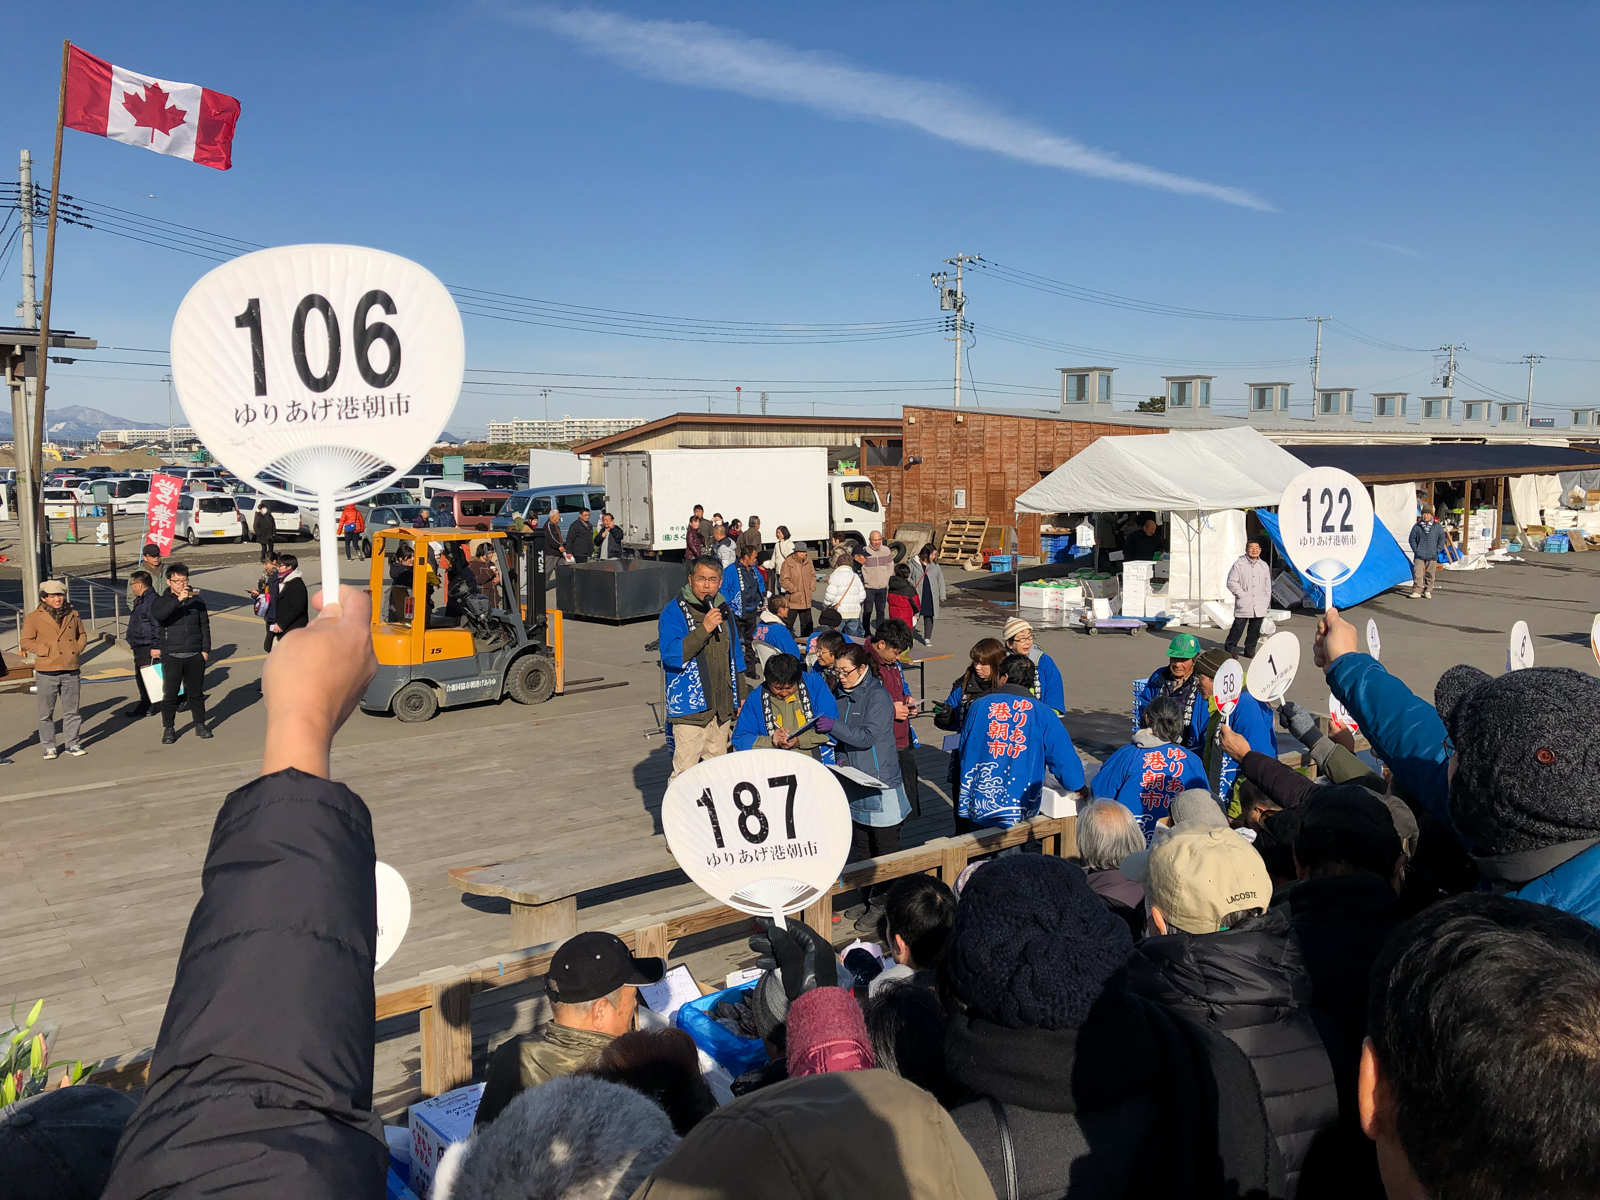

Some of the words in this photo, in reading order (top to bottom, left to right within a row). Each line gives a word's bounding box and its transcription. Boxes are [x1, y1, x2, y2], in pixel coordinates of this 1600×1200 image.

[235, 290, 401, 396] 106
[234, 393, 411, 427] ゆりあげ港朝市
[1302, 487, 1354, 534] 122
[1299, 534, 1357, 548] ゆりあげ港朝市
[1222, 673, 1234, 694] 58
[1268, 654, 1278, 676] 1
[987, 702, 1012, 760] 港朝市
[1006, 699, 1033, 759] ゆりあげ
[1140, 751, 1168, 811] 港朝市
[696, 774, 798, 848] 187
[706, 841, 818, 868] ゆりあげ港朝市
[1226, 891, 1258, 905] LACOSTE
